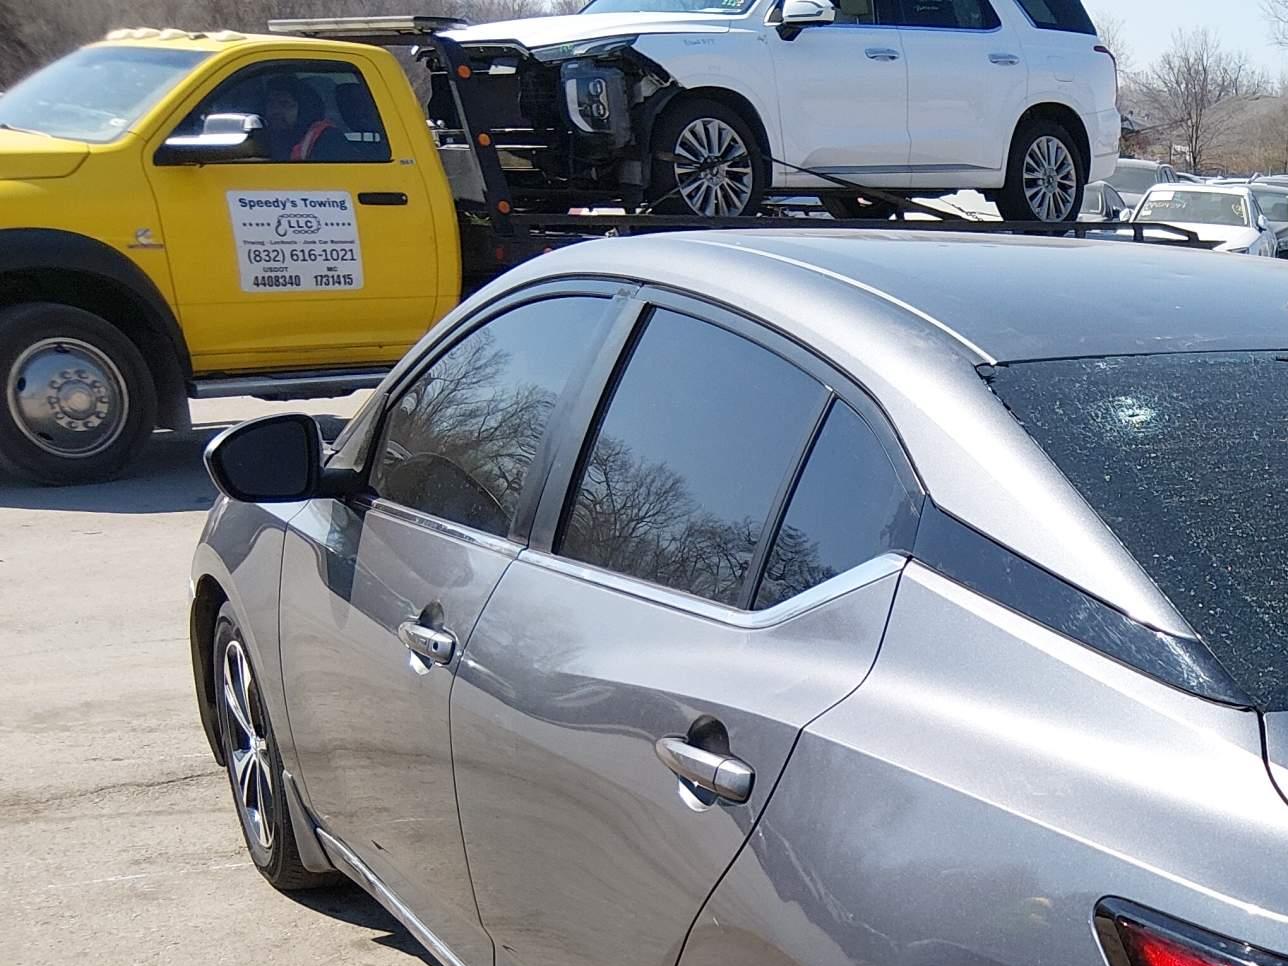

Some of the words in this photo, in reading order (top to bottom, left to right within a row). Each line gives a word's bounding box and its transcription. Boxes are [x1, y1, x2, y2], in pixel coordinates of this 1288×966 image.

[238, 198, 298, 211] Speedy's
[301, 198, 348, 211] Towing
[288, 219, 314, 229] LLC
[247, 248, 286, 264] (832)
[290, 248, 357, 262] 616-1021
[253, 274, 302, 288] 4408340
[313, 274, 354, 287] 1731415
